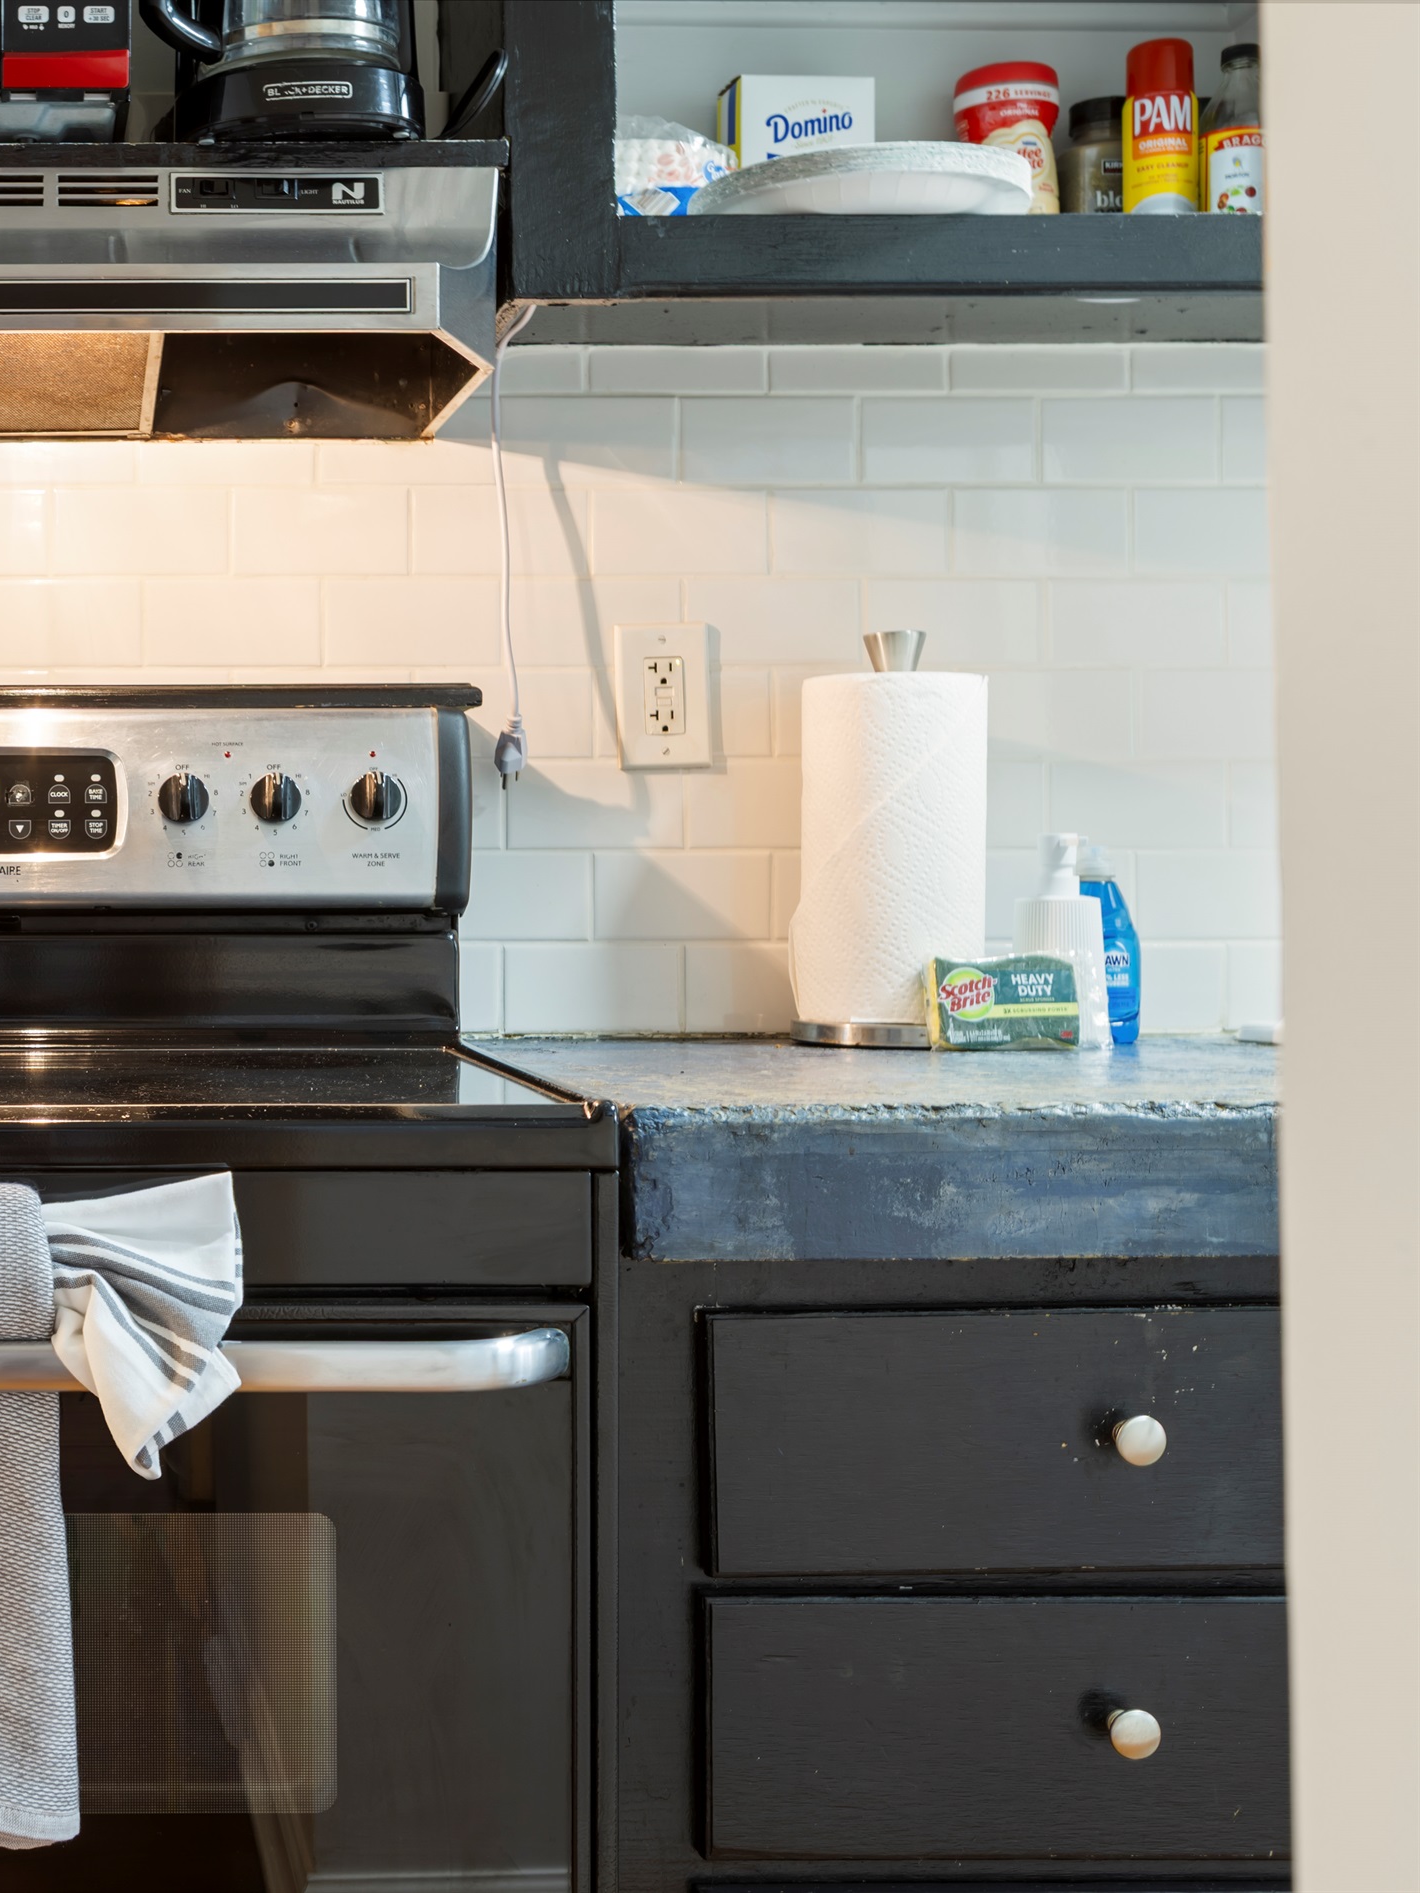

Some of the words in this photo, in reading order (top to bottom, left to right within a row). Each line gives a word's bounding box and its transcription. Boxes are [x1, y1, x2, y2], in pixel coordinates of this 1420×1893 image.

[986, 88, 1011, 101] 226
[1000, 108, 1039, 117] ORIGINAL
[1134, 94, 1191, 137] PAM
[765, 108, 853, 144] Domino
[1138, 137, 1187, 151] ORIGINAL
[1105, 954, 1129, 966] AWN
[1010, 973, 1054, 985] HEAVY
[1017, 984, 1052, 997] DUTY
[950, 991, 991, 1012] Brite
